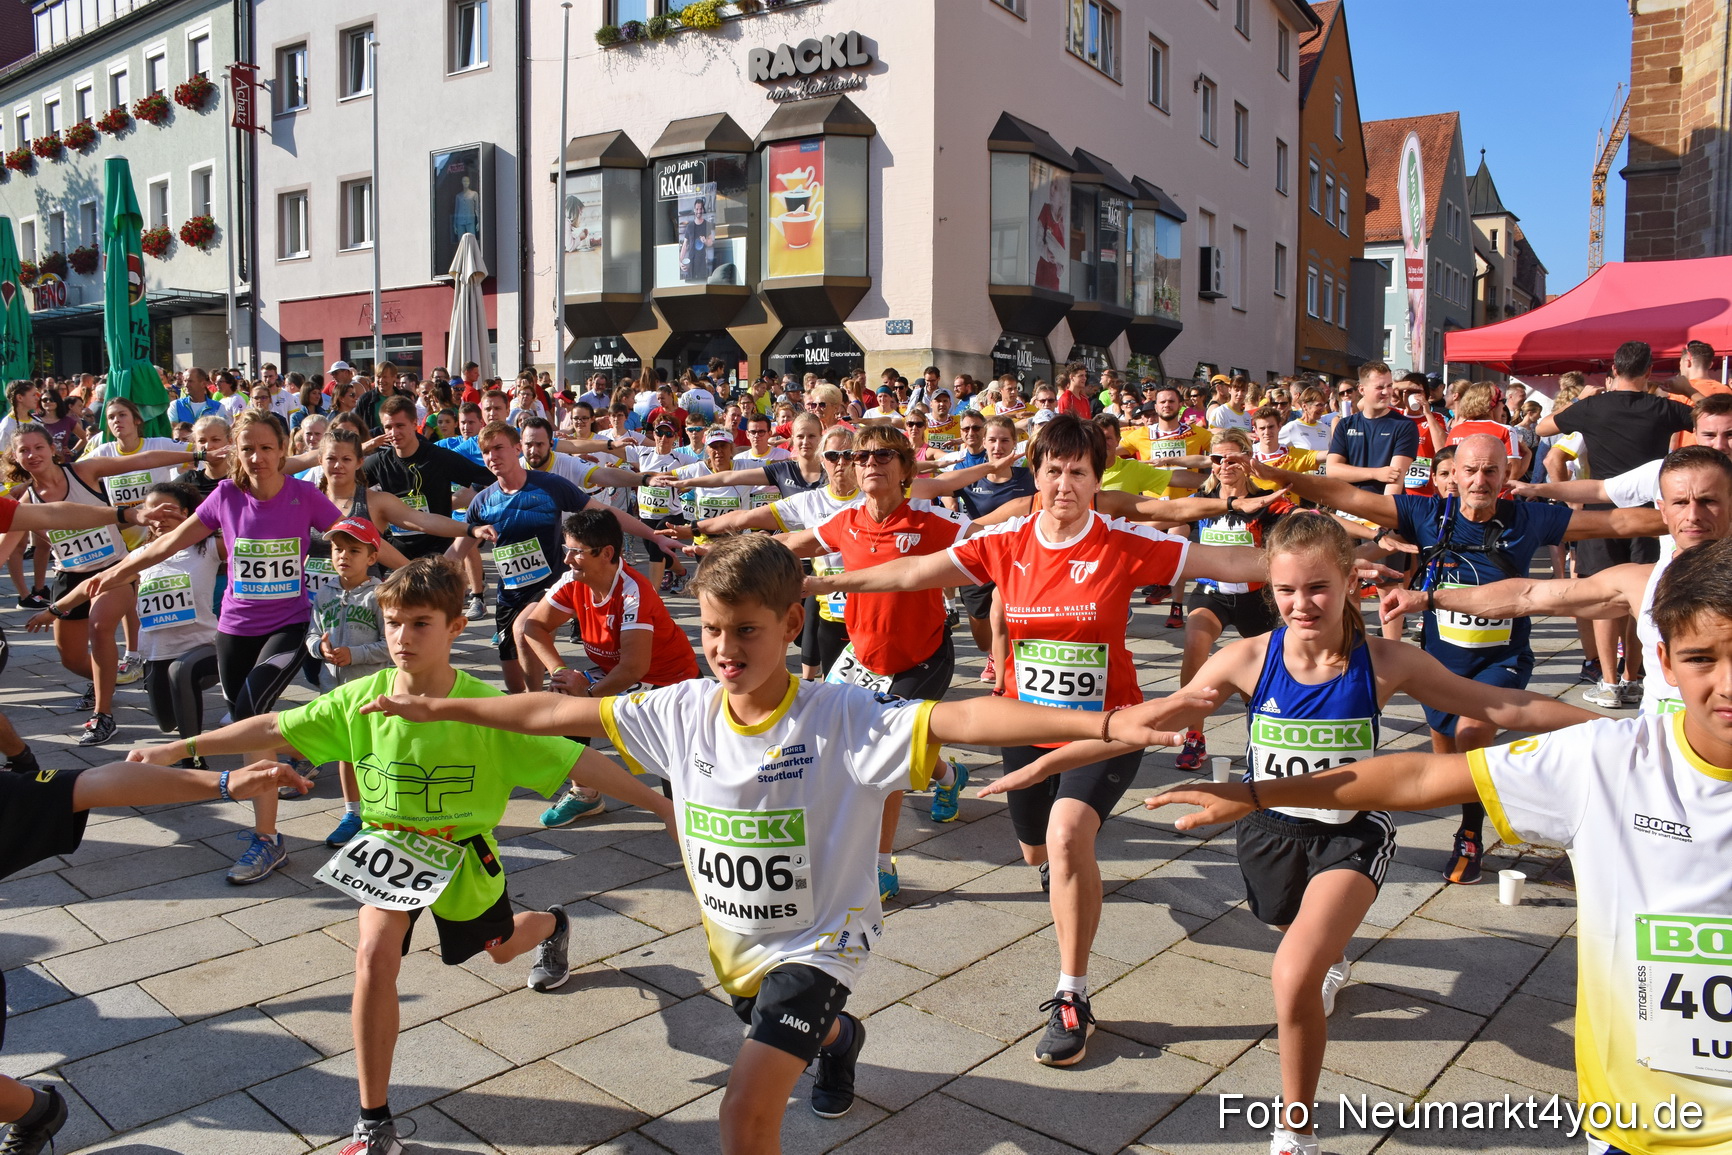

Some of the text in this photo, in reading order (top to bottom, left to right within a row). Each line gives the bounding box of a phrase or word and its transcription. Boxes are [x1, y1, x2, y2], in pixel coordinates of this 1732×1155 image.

[748, 30, 870, 82] RACKL
[766, 75, 863, 100] am Rathaus
[236, 77, 250, 124] Achatz
[664, 160, 698, 175] 100 Jahre
[661, 173, 692, 196] RACKL
[33, 281, 67, 311] RENO
[593, 354, 613, 367] RACKL
[805, 348, 829, 362] RACKL
[1017, 349, 1032, 368] RACKL
[1152, 440, 1182, 448] BOCK
[1155, 449, 1181, 458] 5101
[111, 474, 149, 487] BOCK
[643, 496, 665, 508] 1042
[702, 498, 736, 507] BOCK
[60, 532, 106, 556] 2111
[1204, 531, 1248, 544] BOCK
[239, 541, 295, 555] BOCK
[497, 541, 536, 559] BOCK
[73, 551, 104, 565] CELINA
[309, 560, 336, 572] BOC
[502, 555, 541, 576] 2104
[240, 559, 294, 579] 2616
[516, 573, 536, 583] PAUL
[141, 576, 185, 593] BOCK
[242, 582, 292, 593] SUSANNE
[141, 591, 186, 615] 2101
[1005, 603, 1052, 613] ENGELHARDT
[1064, 602, 1096, 612] WALTER
[153, 613, 178, 624] HANA
[1022, 643, 1098, 664] BOCK
[1024, 666, 1095, 697] 2259
[1260, 706, 1281, 714] adidas
[1261, 722, 1362, 747] BOCK
[783, 745, 804, 756] JAHRE
[758, 756, 814, 772] Neumarkter
[758, 769, 804, 783] Stadtlauf
[220, 773, 229, 799] NOAH
[454, 811, 473, 819] GmbH
[692, 808, 791, 842] BOCK
[1634, 813, 1692, 838] BOCK
[347, 840, 438, 891] 4026
[698, 847, 794, 892] 4006
[331, 869, 421, 906] LEONHARD
[703, 893, 798, 920] JOHANNES
[838, 930, 850, 948] 2019
[780, 1013, 811, 1033] JAKO
